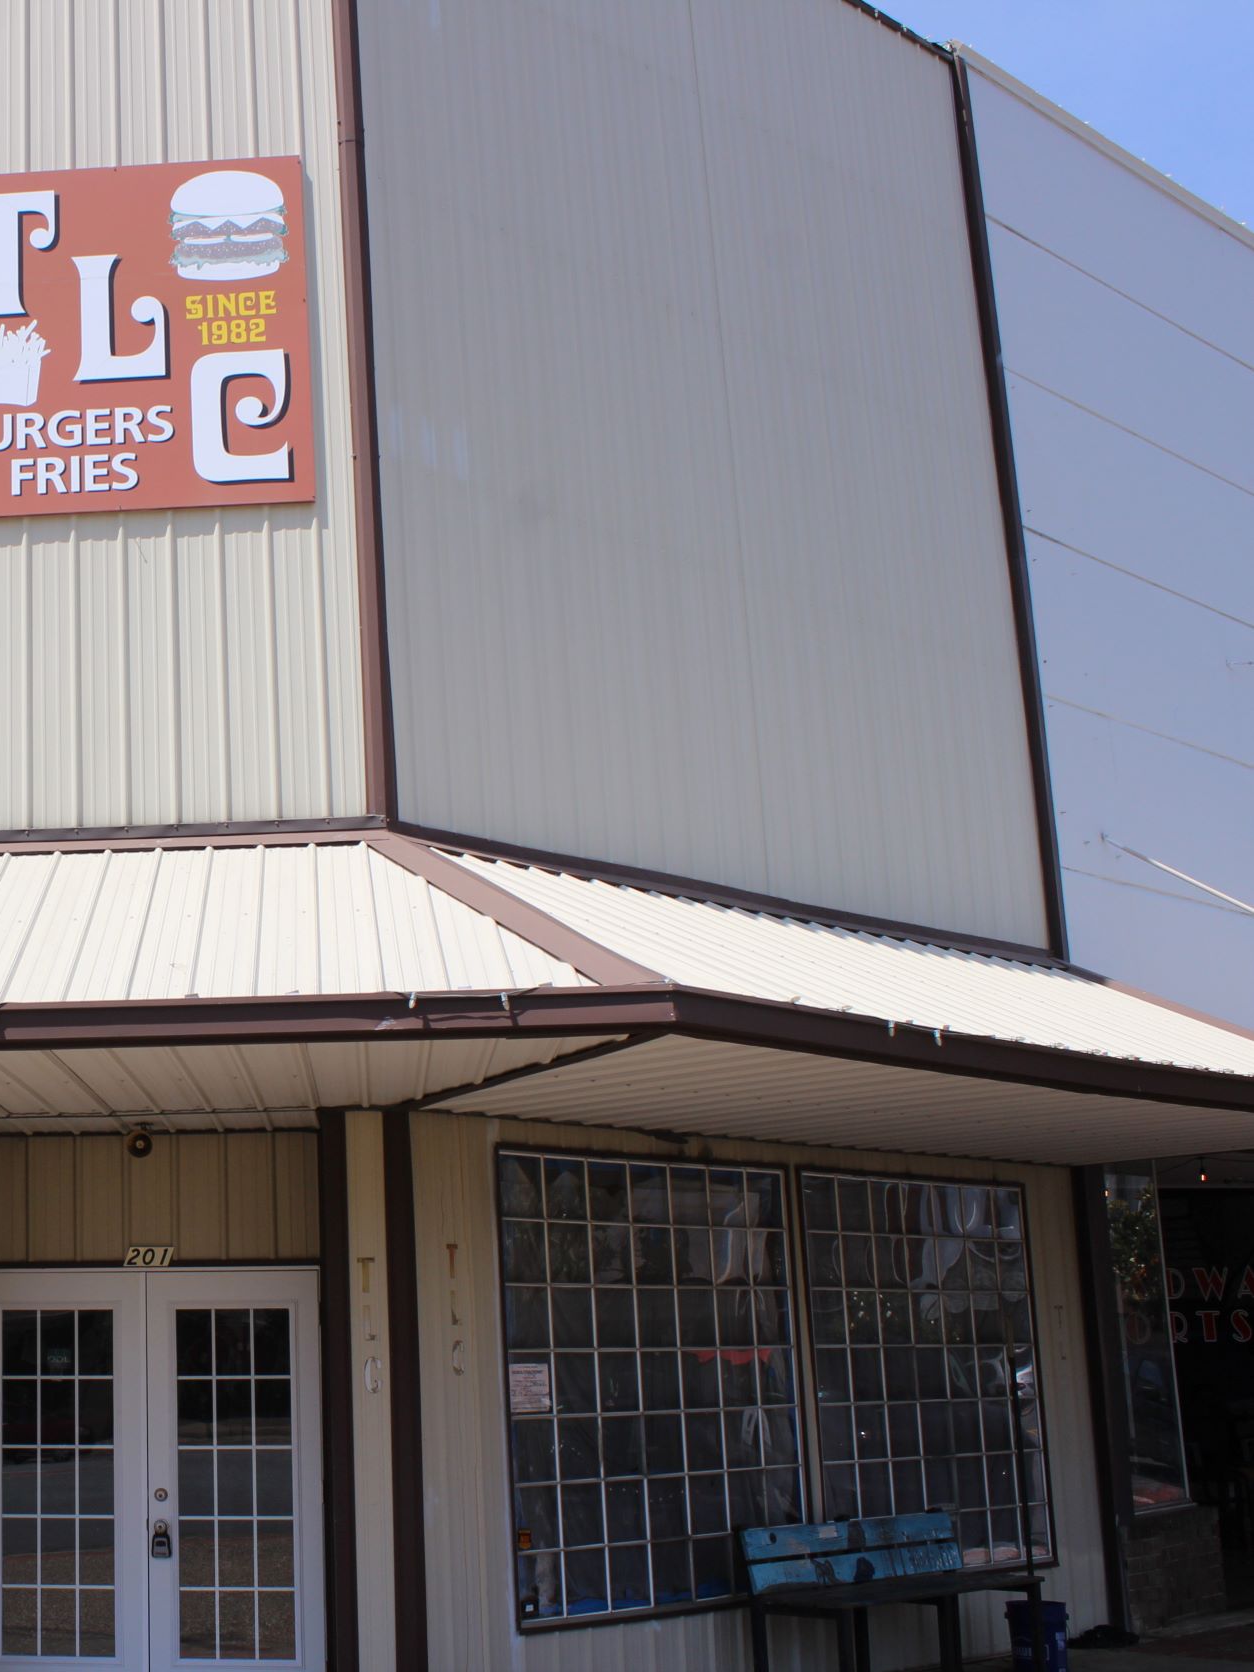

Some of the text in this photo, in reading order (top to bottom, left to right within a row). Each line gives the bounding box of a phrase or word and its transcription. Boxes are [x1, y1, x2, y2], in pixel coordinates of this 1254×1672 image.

[185, 290, 277, 320] SINCE
[197, 318, 267, 346] 1982
[10, 452, 140, 498] FRIES
[126, 1247, 169, 1266] 201
